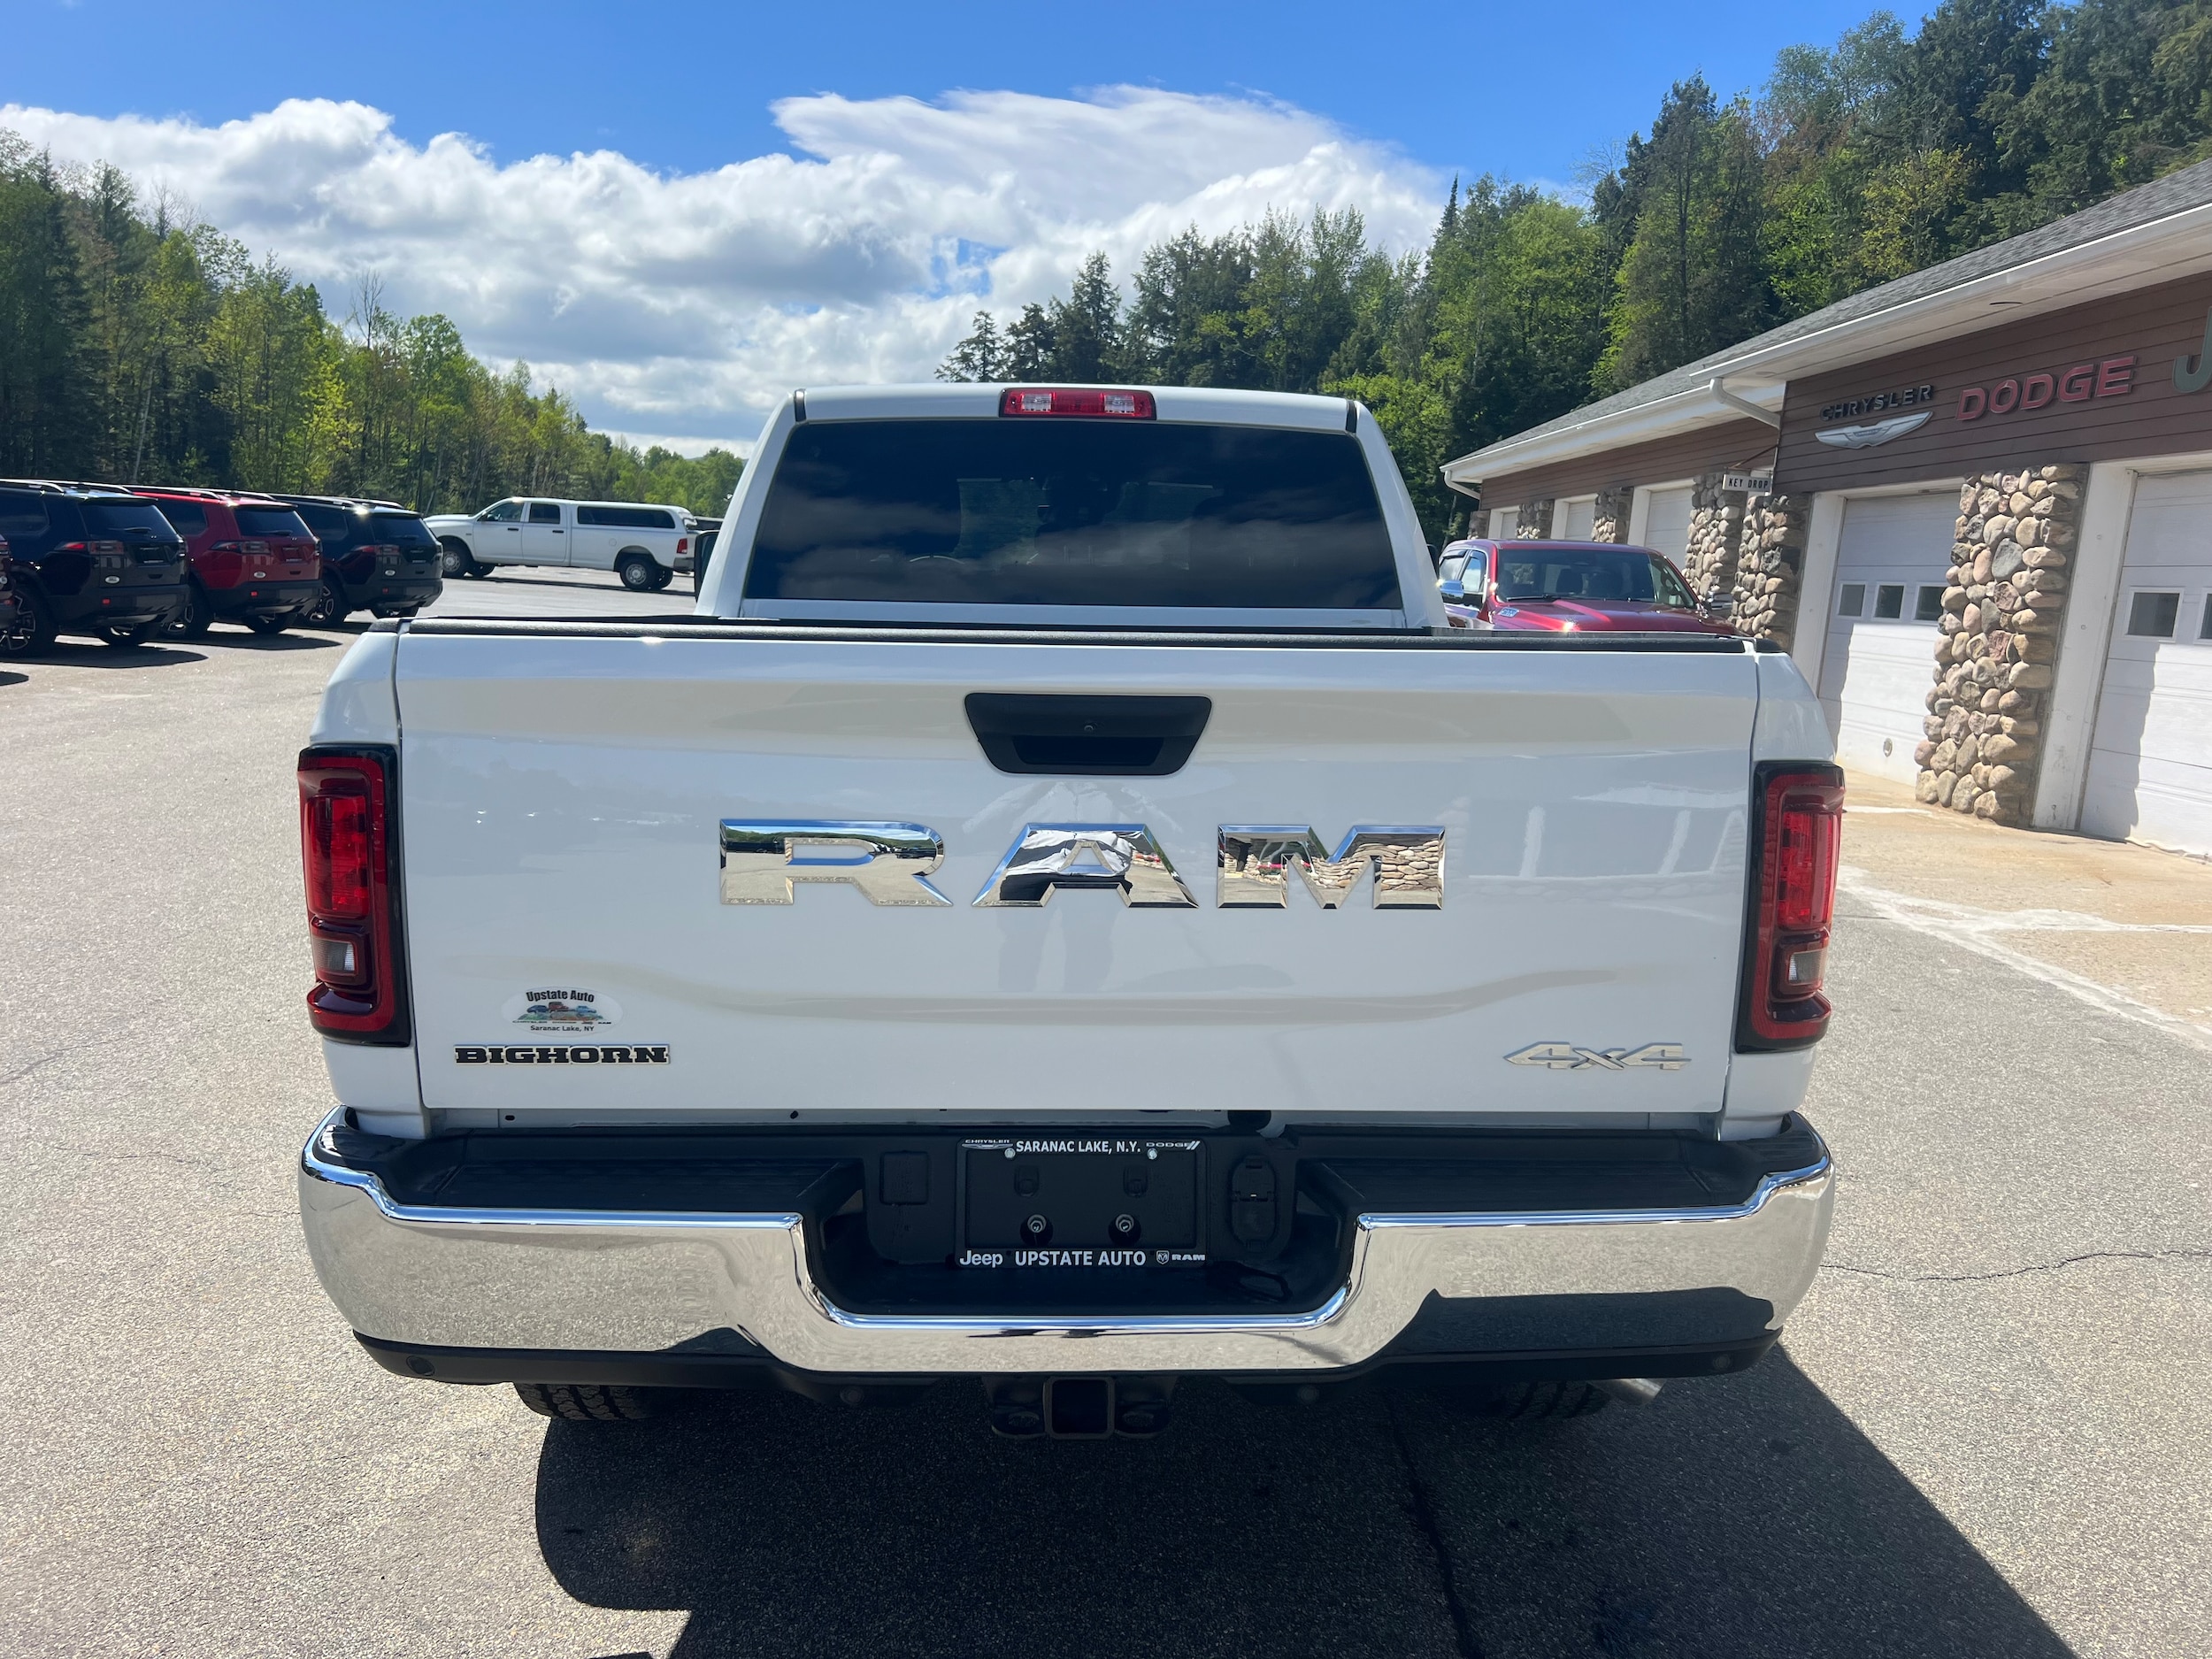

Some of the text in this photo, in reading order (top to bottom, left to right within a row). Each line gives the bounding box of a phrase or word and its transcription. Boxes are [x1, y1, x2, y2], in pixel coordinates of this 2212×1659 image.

[1955, 355, 2137, 421] DODGE
[1820, 384, 1932, 421] CHRYSLER
[1728, 478, 1769, 489] KEY DROP
[719, 819, 1447, 910] RAM
[526, 990, 595, 1002] Upstate Auto
[454, 1045, 669, 1064] BIGHORN
[1016, 1141, 1141, 1154] SARANAC LAKE, N.Y.
[960, 1250, 1003, 1268] Jeep
[1015, 1250, 1147, 1266] UPSTATE AUTO
